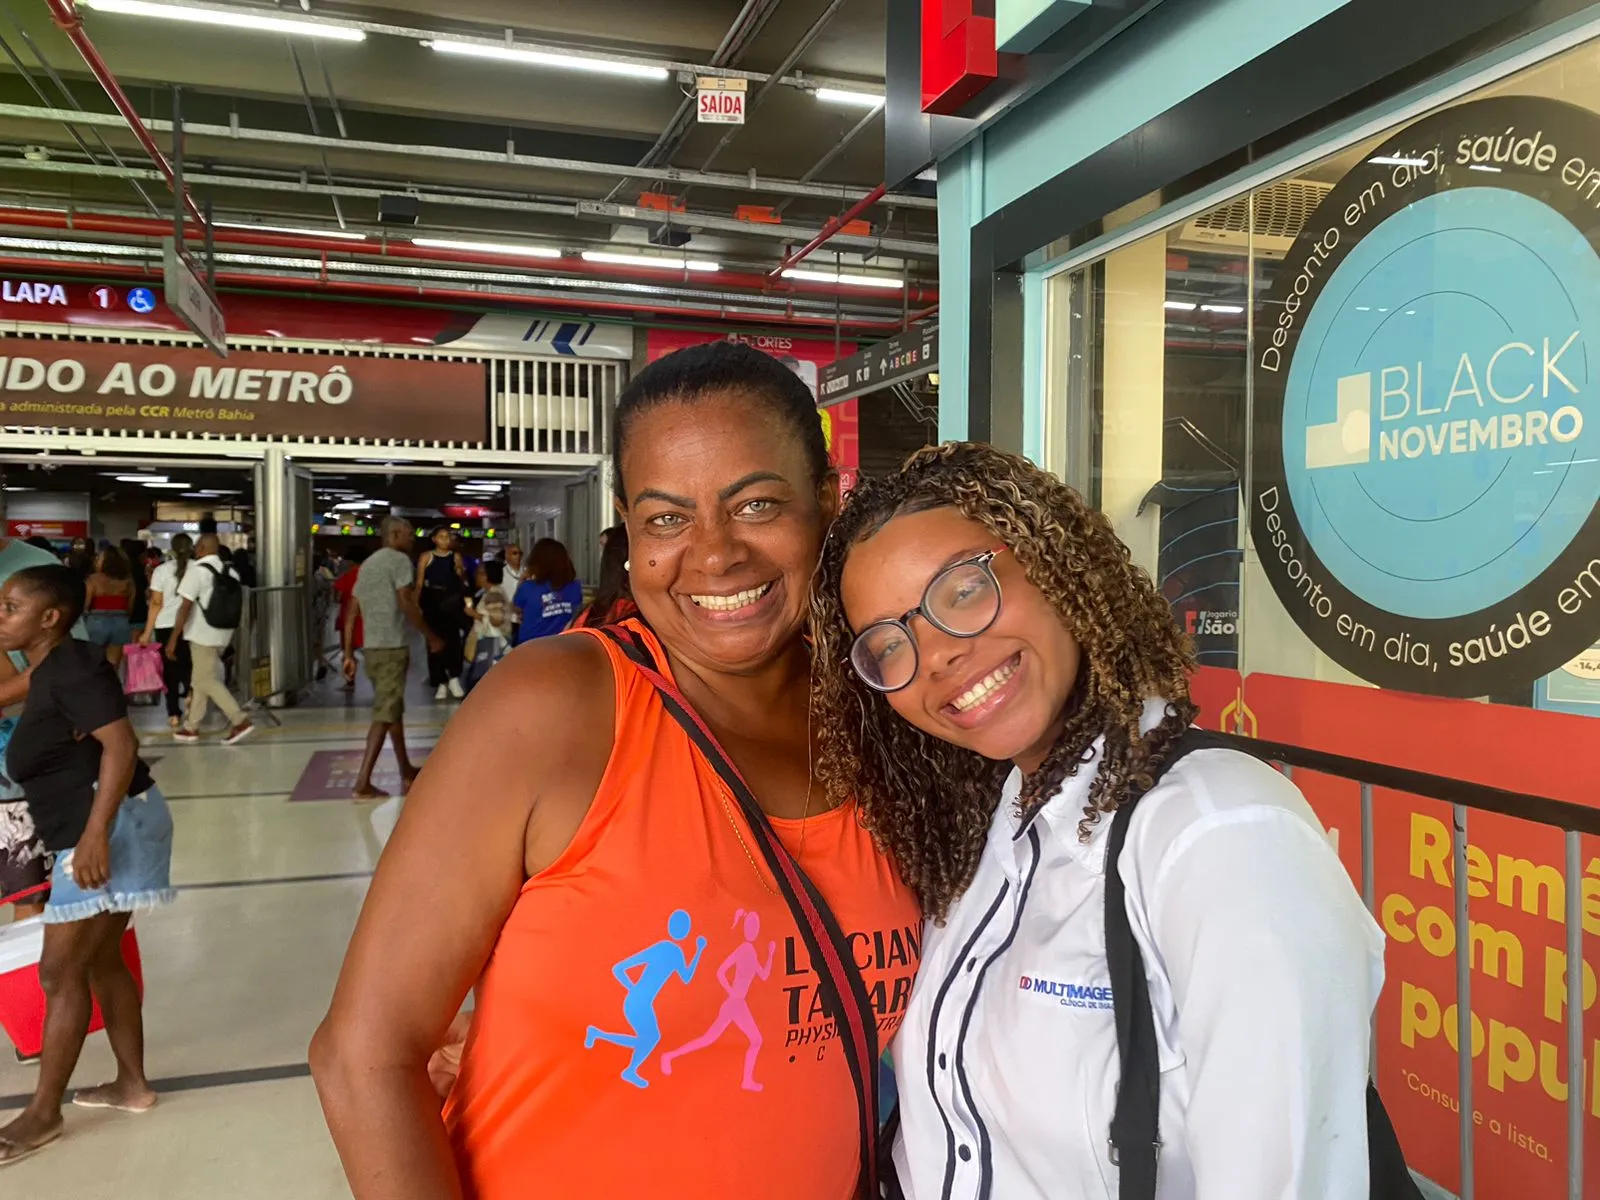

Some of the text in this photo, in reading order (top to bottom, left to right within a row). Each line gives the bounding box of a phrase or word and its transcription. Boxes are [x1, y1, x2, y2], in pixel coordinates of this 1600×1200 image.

[700, 91, 742, 114] SAÍDA
[1260, 227, 1340, 372] Desconto
[1343, 180, 1386, 226] em
[1456, 126, 1557, 172] saúde
[2, 280, 109, 309] LAPA 1
[97, 361, 177, 397] AO
[189, 365, 353, 404] METRÔ
[1380, 330, 1580, 422] BLACK
[9, 401, 102, 416] administrada
[105, 404, 136, 417] pela
[139, 405, 170, 418] CCR
[218, 407, 255, 421] Bahia
[1379, 405, 1584, 462] NOVEMBRO
[1259, 486, 1333, 619] Desconto
[1336, 613, 1376, 653] em
[1383, 632, 1439, 673] dia,
[1449, 610, 1552, 667] saúde
[1204, 619, 1236, 635] São
[1382, 893, 1523, 988] com
[1489, 1119, 1501, 1136] a
[1507, 1122, 1553, 1163] lista.
